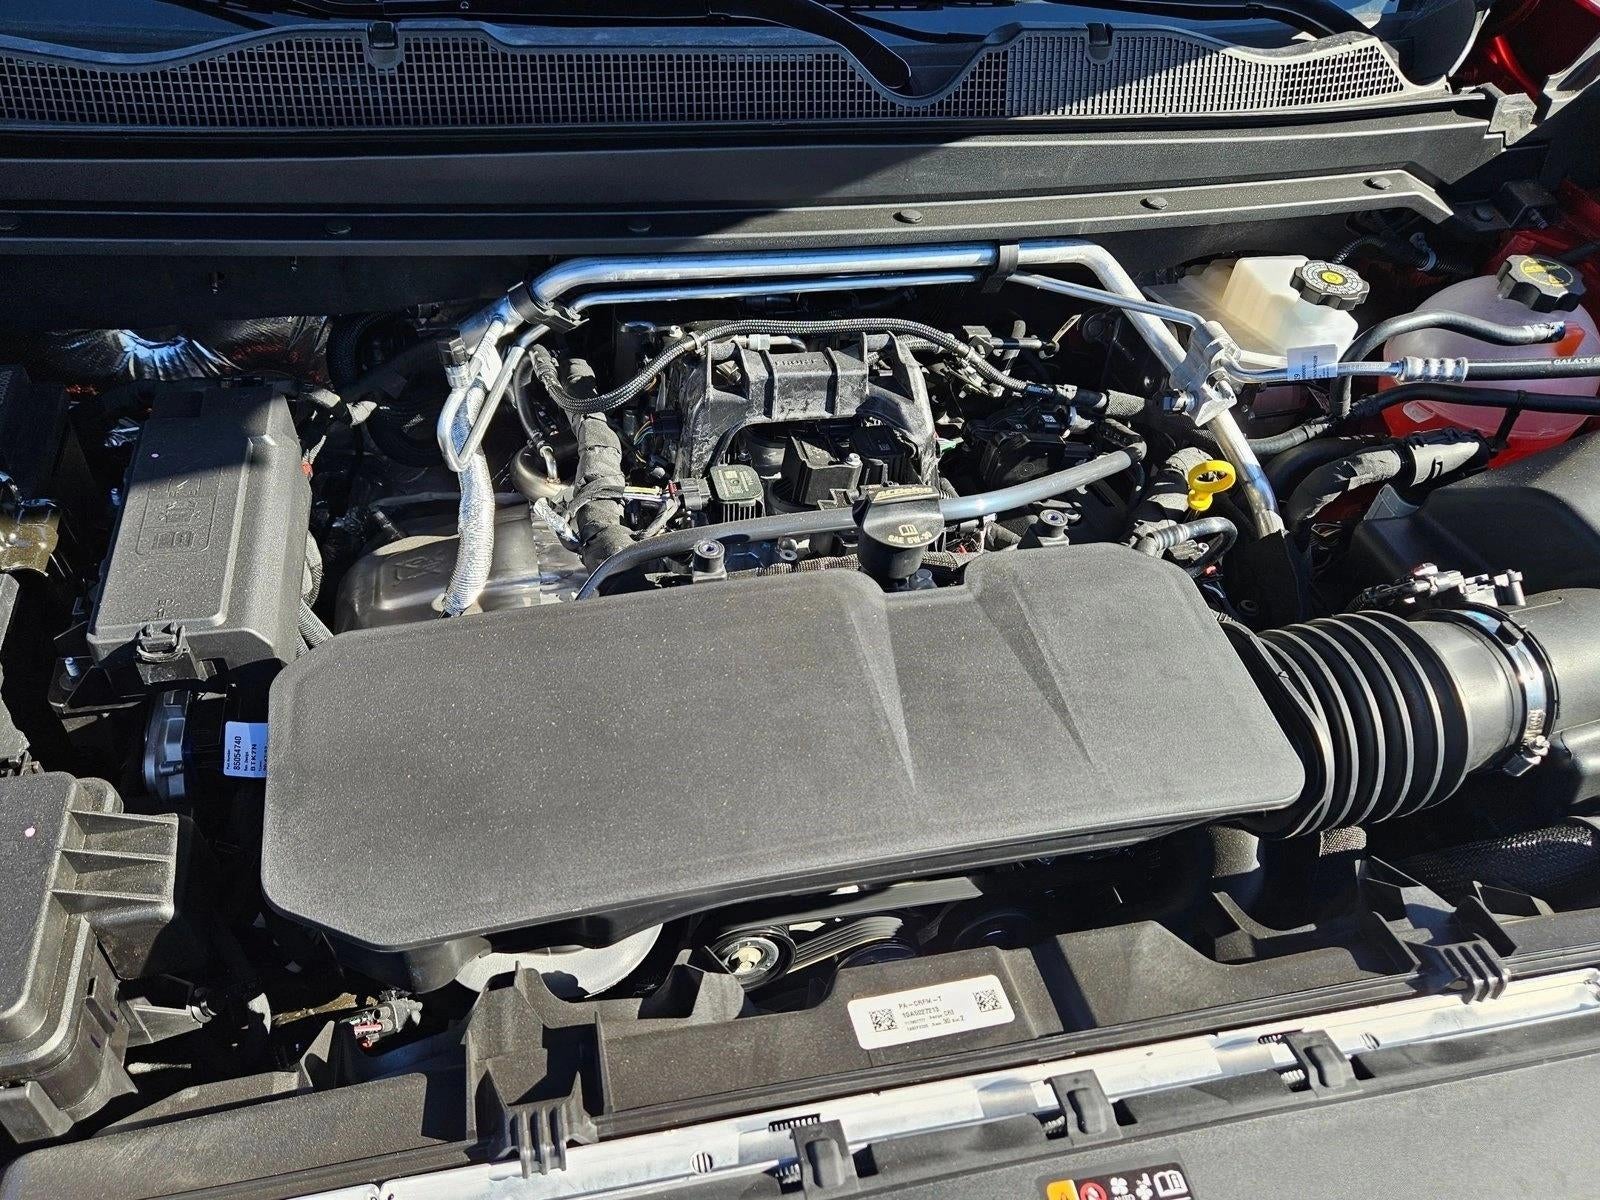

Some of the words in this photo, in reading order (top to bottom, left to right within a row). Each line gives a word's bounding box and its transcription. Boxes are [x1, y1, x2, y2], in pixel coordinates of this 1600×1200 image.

[1553, 357, 1592, 365] GALAXY
[888, 534, 904, 544] SAE
[233, 736, 242, 770] 85054740
